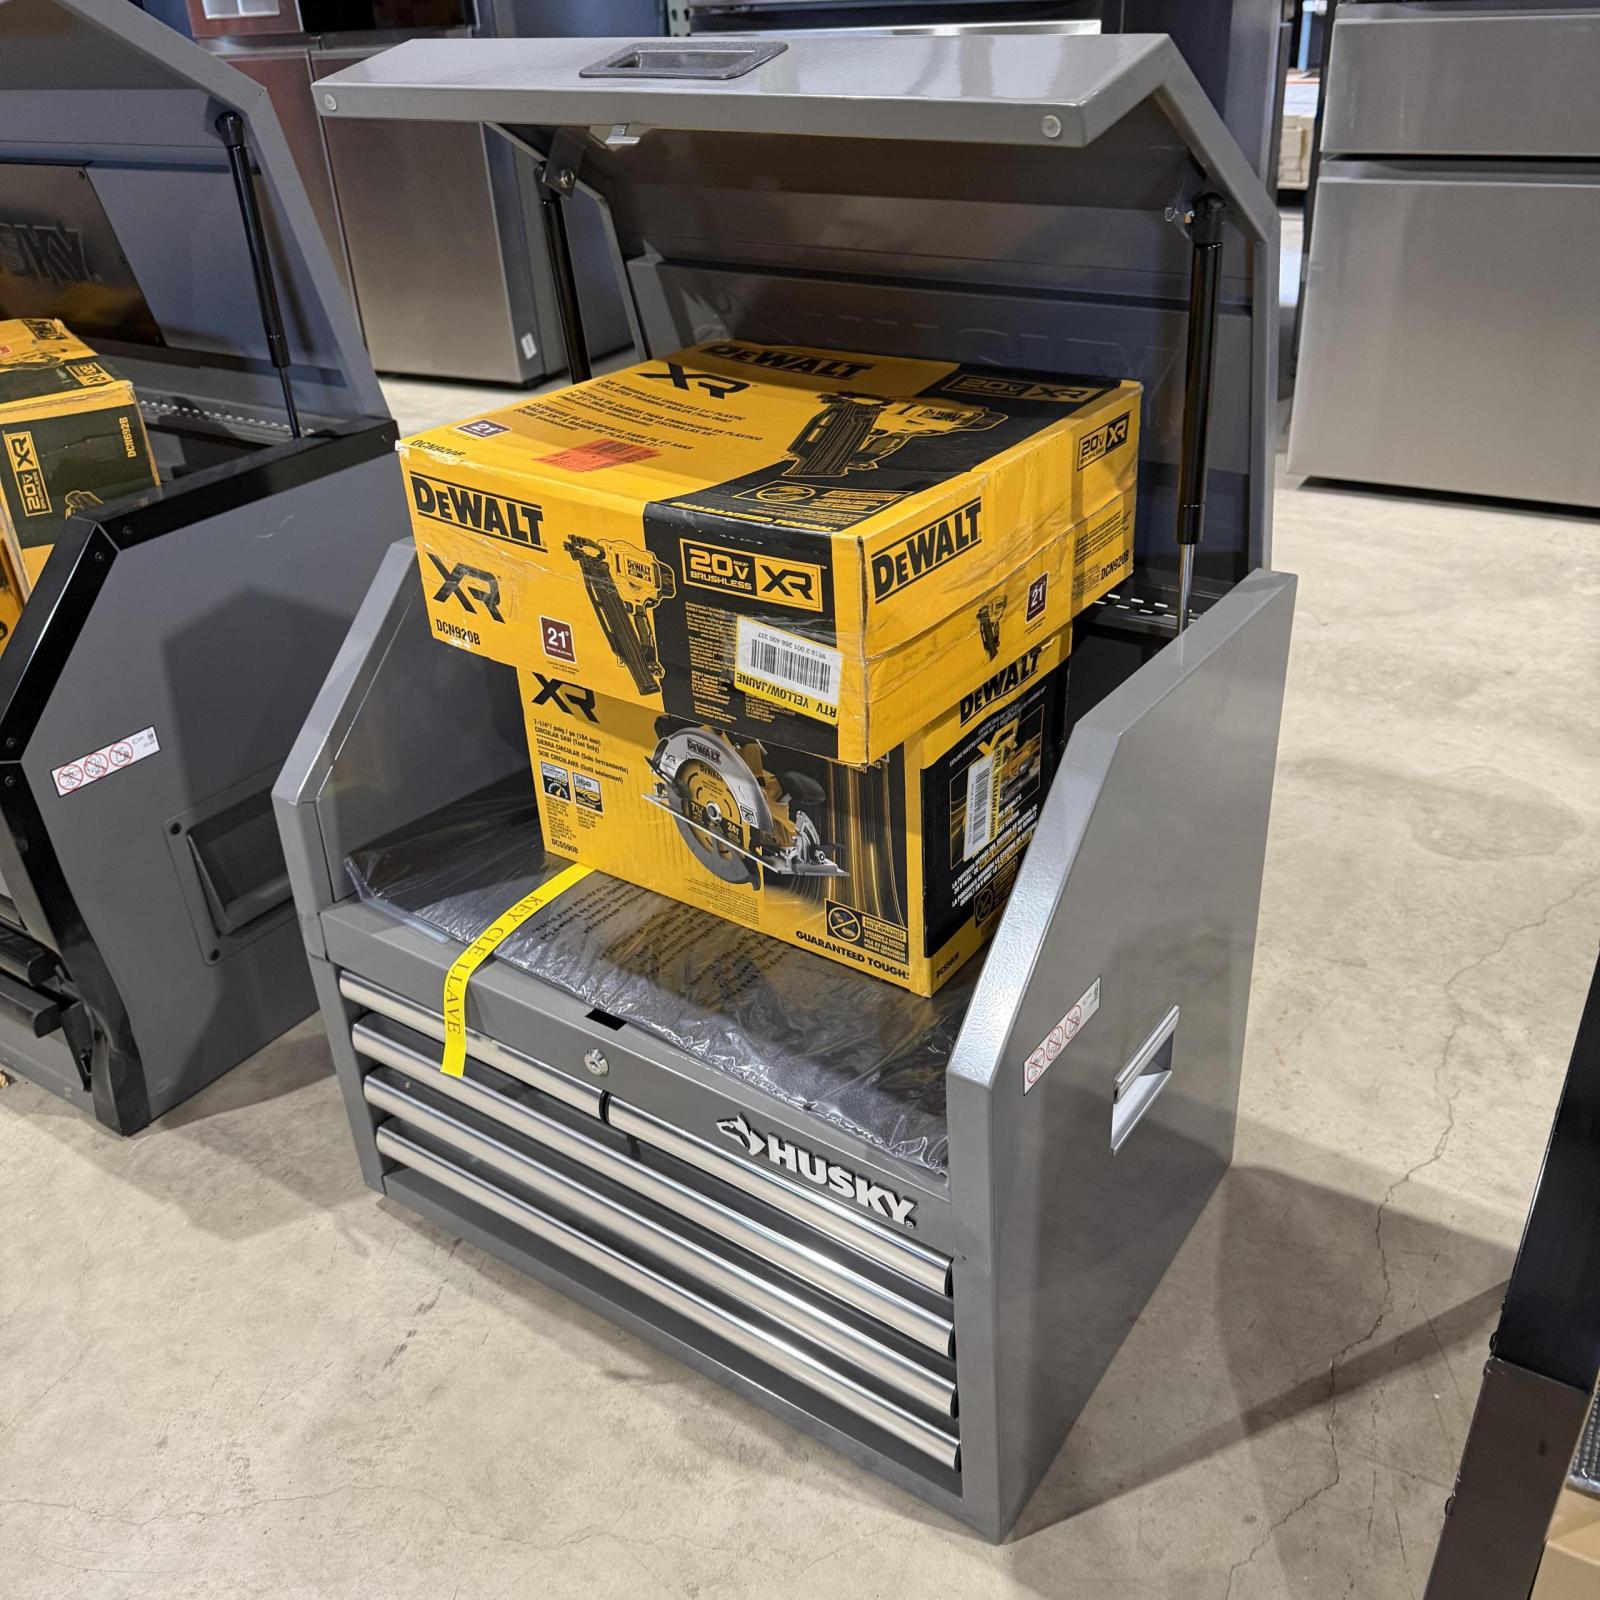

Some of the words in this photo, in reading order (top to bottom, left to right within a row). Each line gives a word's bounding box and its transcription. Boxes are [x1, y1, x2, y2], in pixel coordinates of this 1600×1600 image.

[703, 345, 875, 378] DEWALT
[636, 361, 750, 399] XR
[1031, 386, 1089, 399] XR
[1108, 420, 1127, 448] XR
[10, 437, 33, 469] XR
[410, 476, 546, 547] DEWALT
[872, 501, 982, 597] DEWALT
[426, 552, 506, 624] XR
[690, 570, 752, 591] BRUSHLESS
[759, 564, 816, 601] XR
[436, 618, 481, 646] DCN920B
[546, 626, 571, 649] 21°
[531, 672, 600, 723] XR
[736, 673, 809, 708] YELLOW/JAUNE
[816, 702, 837, 717] RTV
[507, 896, 543, 922] KEY
[468, 927, 504, 957] CLE
[796, 930, 865, 962] GUARANTEED
[446, 963, 470, 1034] LLAVE
[768, 1132, 917, 1227] HUSKY
